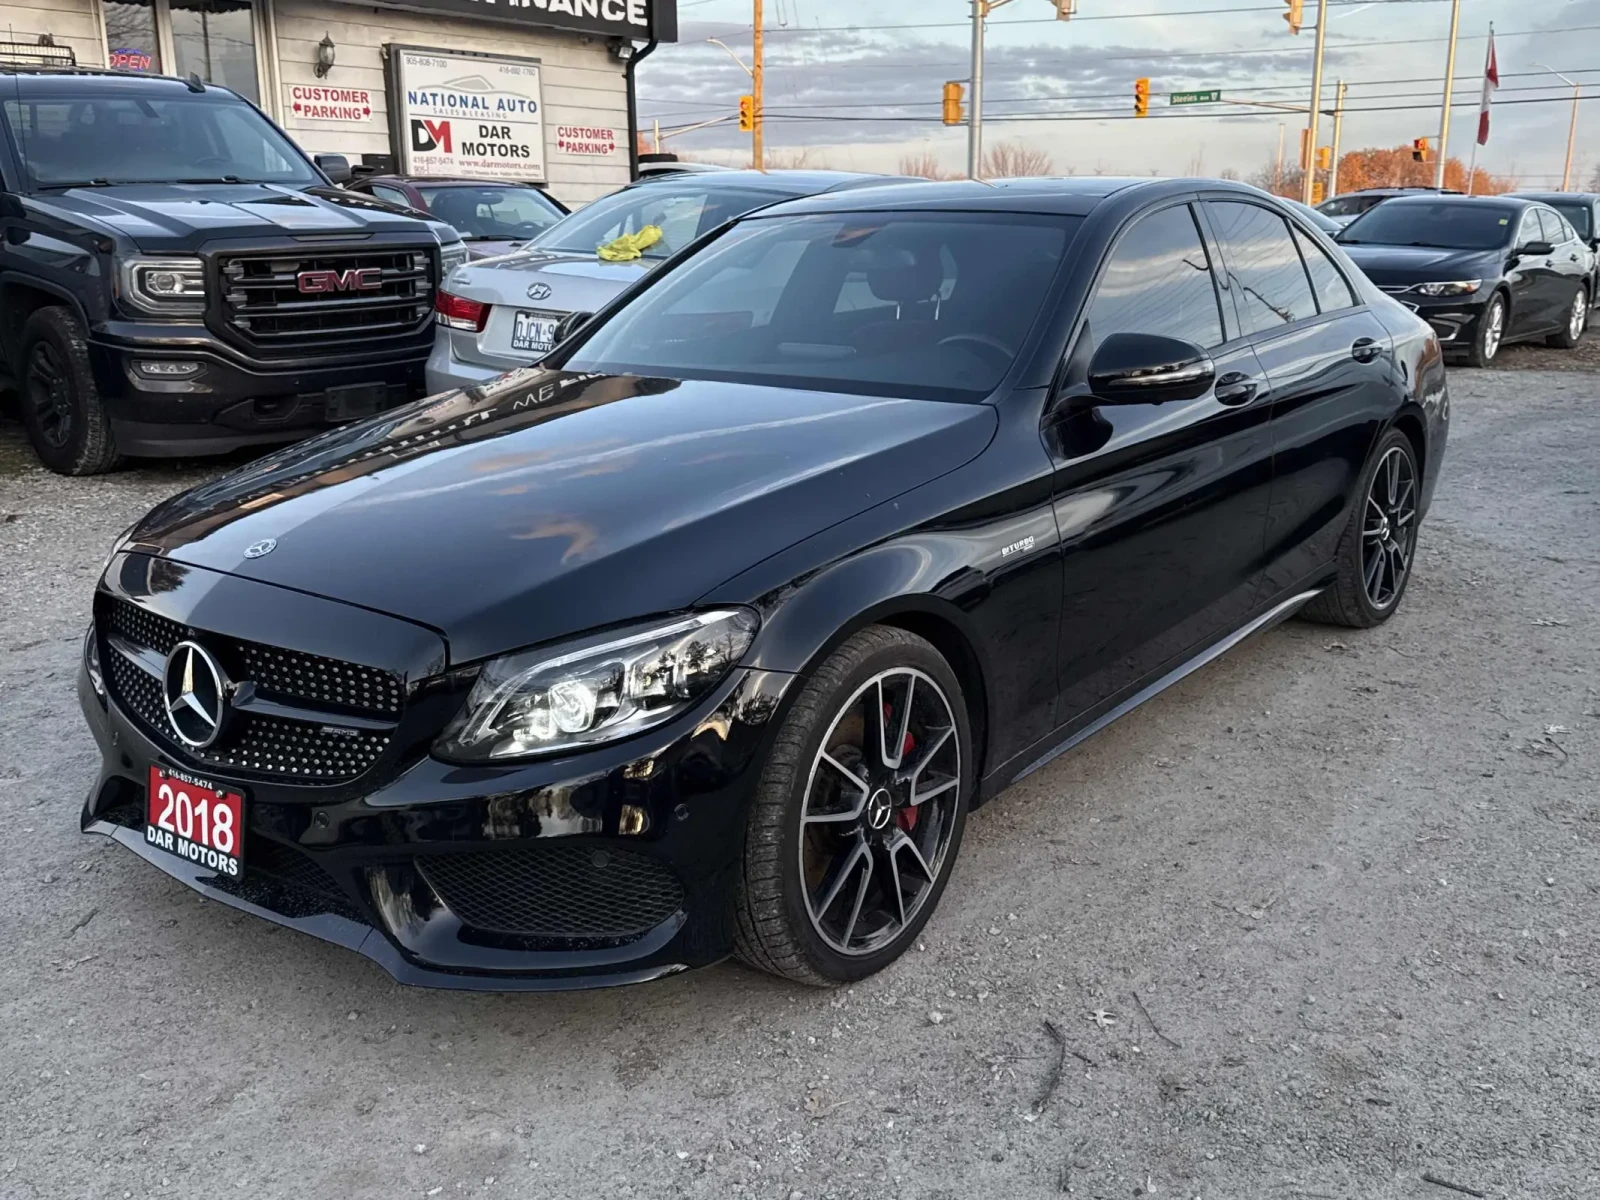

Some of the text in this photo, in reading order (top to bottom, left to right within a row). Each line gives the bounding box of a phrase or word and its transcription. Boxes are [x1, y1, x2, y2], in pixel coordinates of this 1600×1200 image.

[486, 0, 648, 26] ANCE
[109, 53, 152, 70] OPEN
[293, 87, 369, 104] CUSTOMER
[408, 91, 537, 114] NATIONAL AUTO
[303, 105, 361, 120] PARKING
[433, 107, 460, 116] SALES
[469, 112, 507, 120] LEASING
[410, 119, 453, 154] DM
[479, 125, 512, 140] DAR
[558, 127, 614, 140] CUSTOMER
[462, 142, 530, 158] MOTORS
[566, 141, 608, 154] PARKING
[459, 160, 540, 171] www.darmotors.com
[297, 267, 382, 293] GMC
[513, 340, 530, 349] DAR
[531, 342, 553, 351] MOT
[1001, 536, 1034, 556] BITURBO
[168, 768, 213, 790] 416-857-5474
[157, 784, 234, 853] 2018
[147, 825, 238, 876] DAR MOTORS
